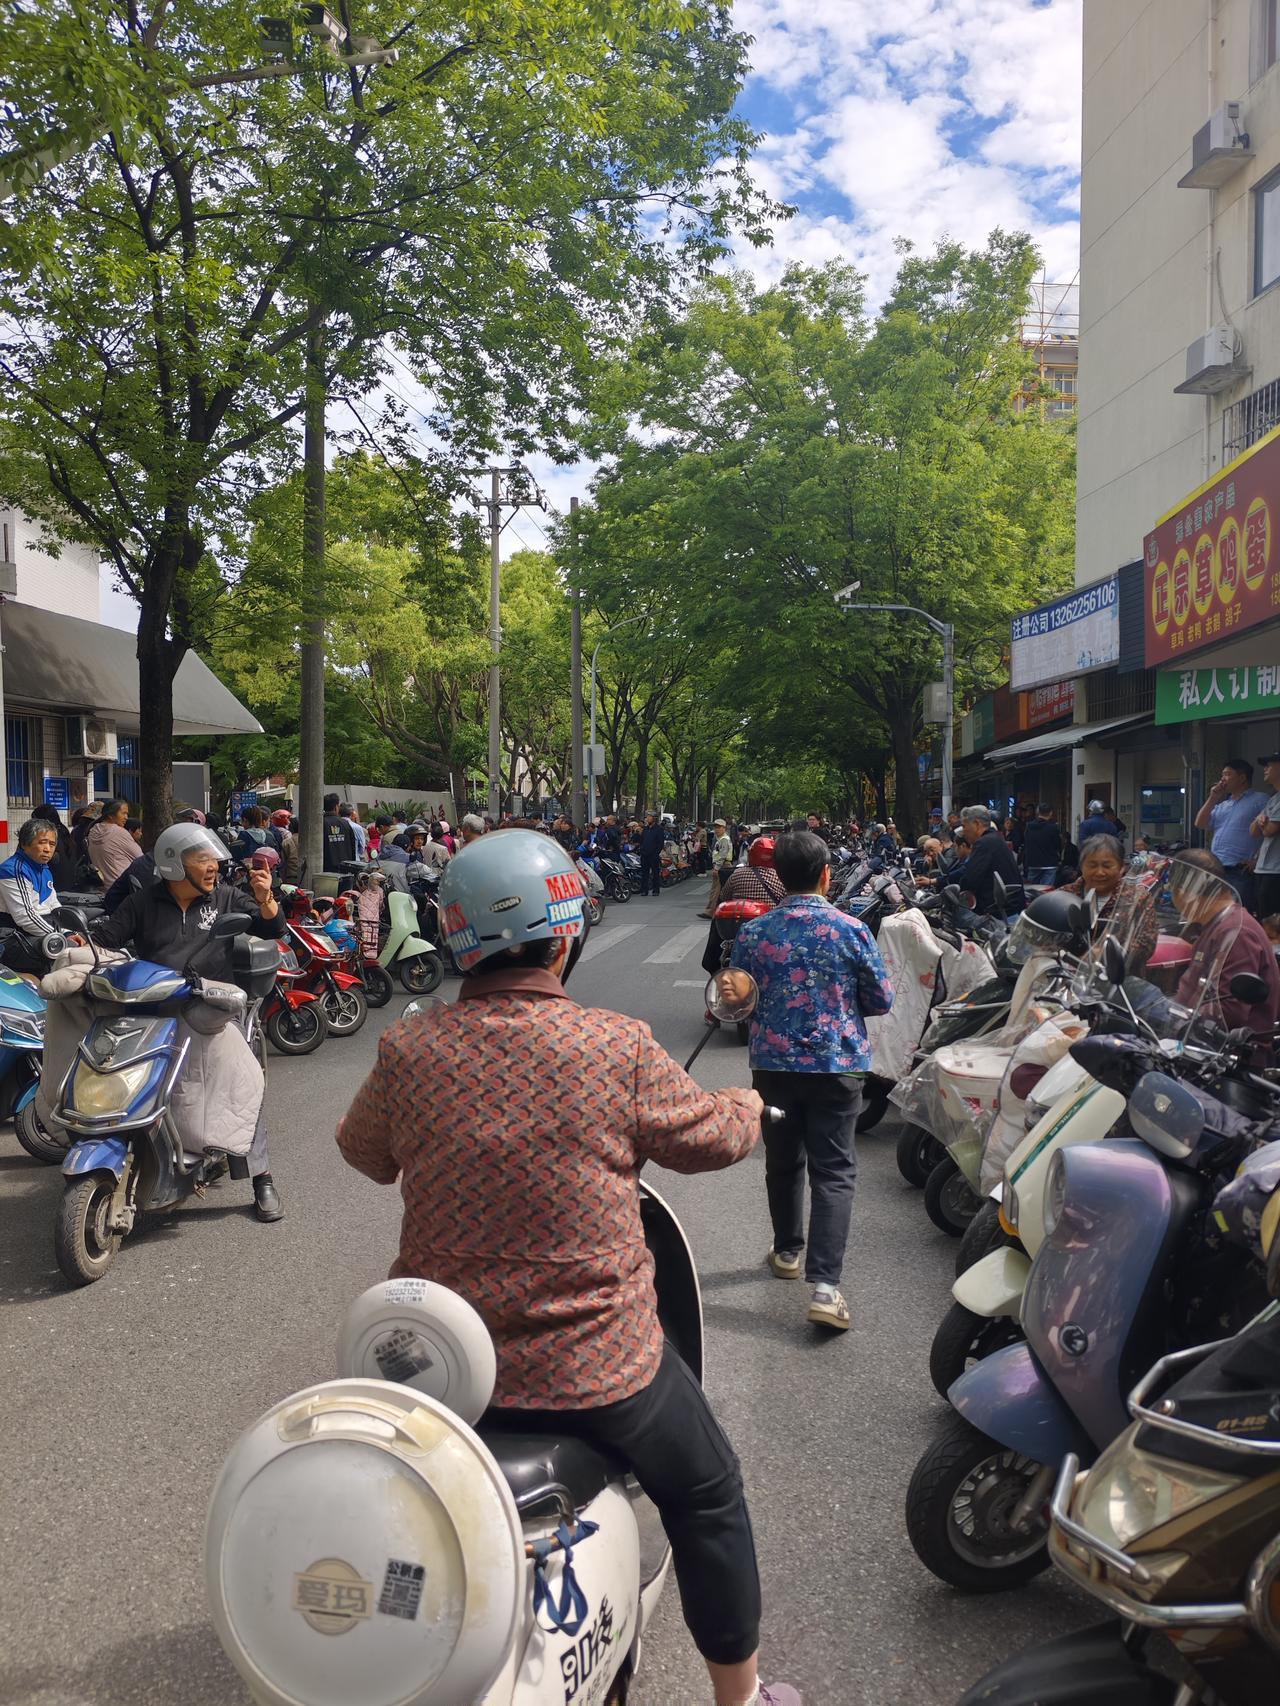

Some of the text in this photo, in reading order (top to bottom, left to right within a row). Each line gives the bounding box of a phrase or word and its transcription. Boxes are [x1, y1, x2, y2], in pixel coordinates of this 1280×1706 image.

[1012, 580, 1116, 640] 注册公司 13262256106
[1179, 665, 1280, 709] 私人订制
